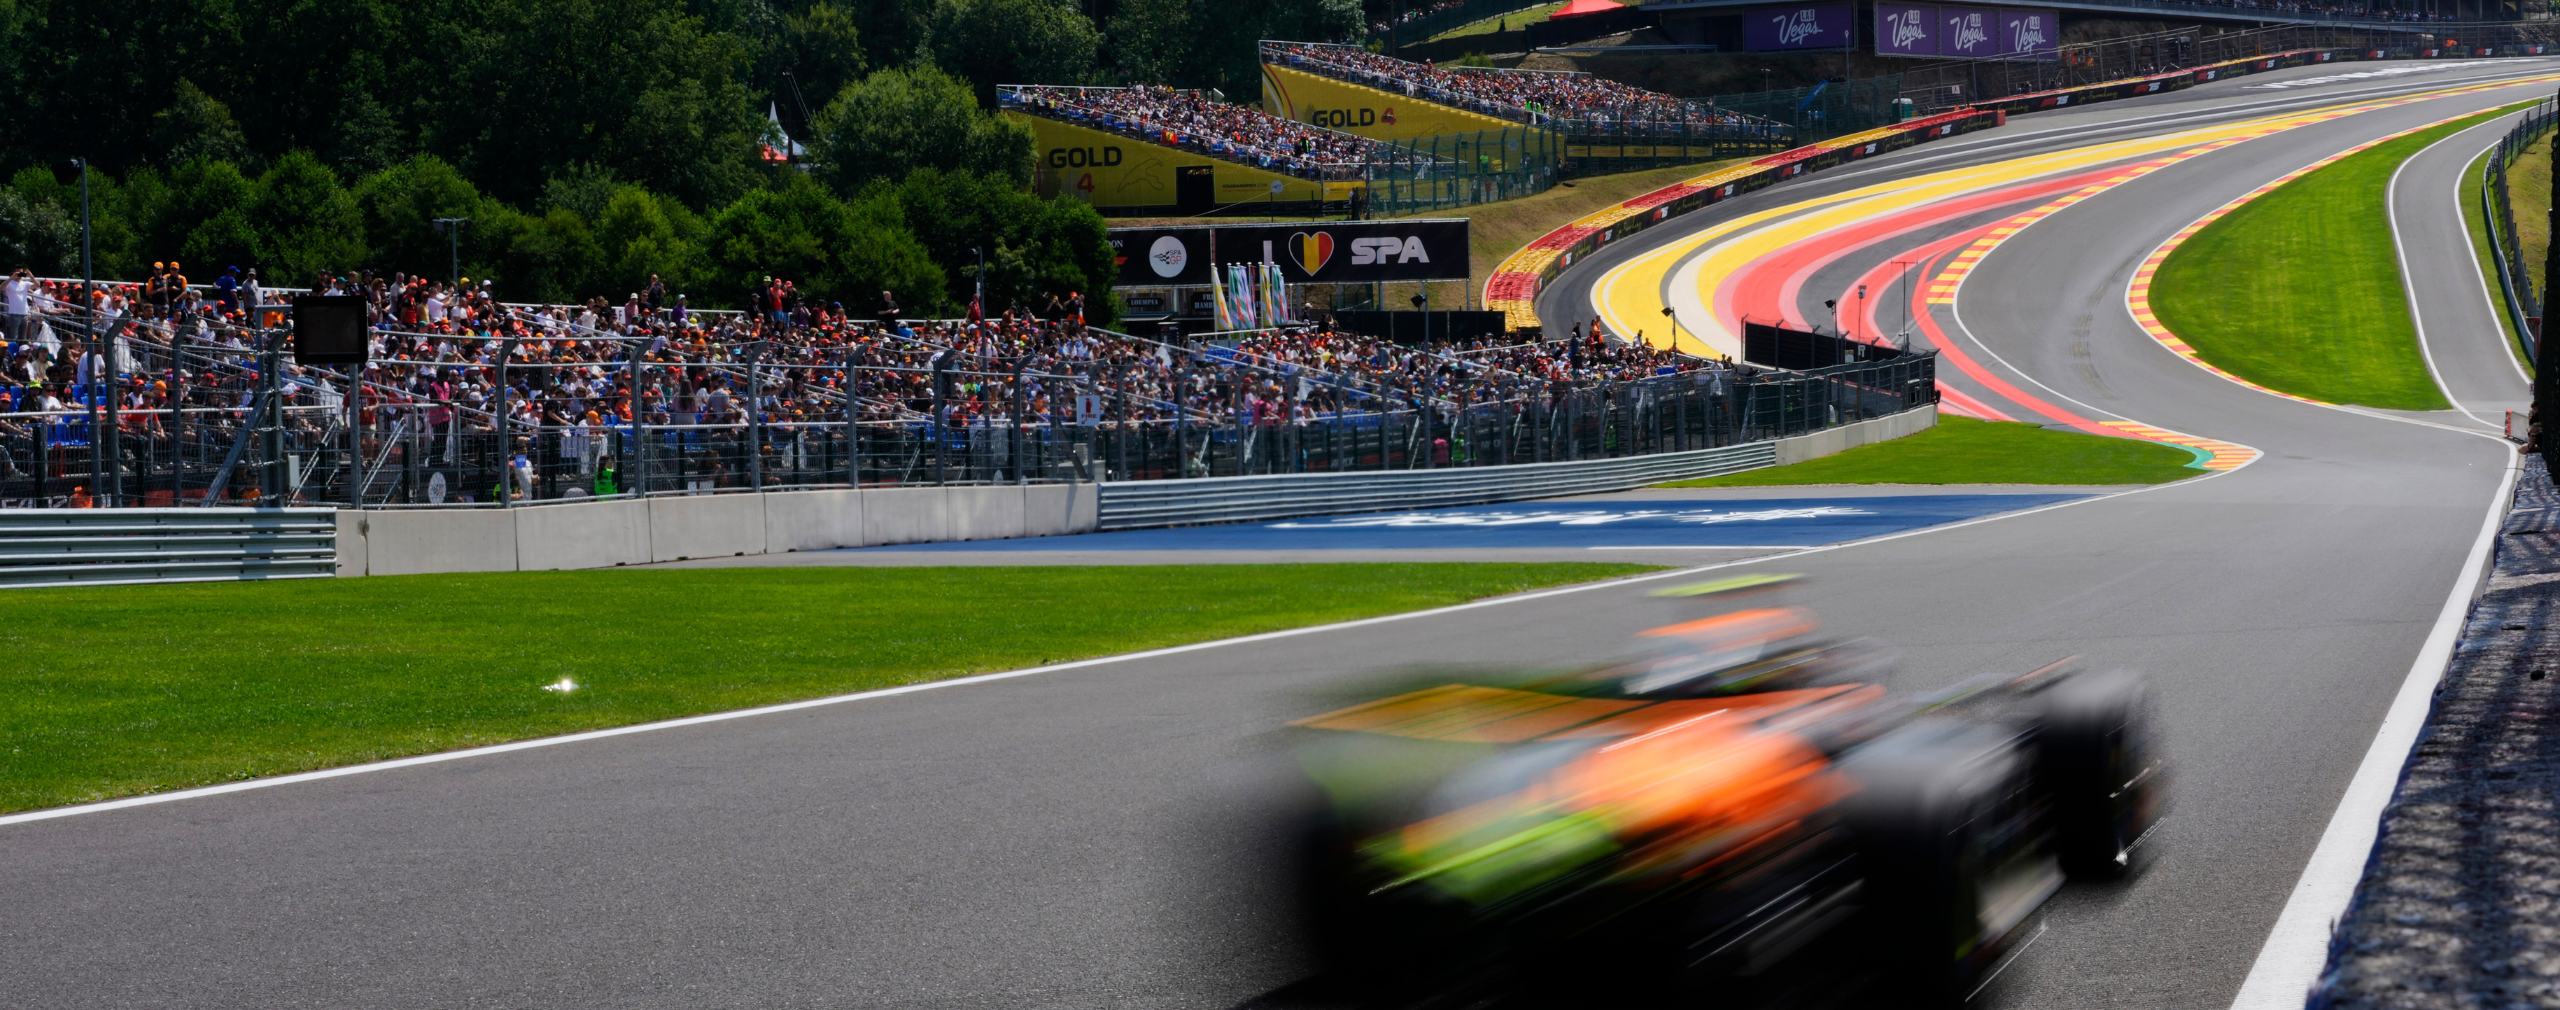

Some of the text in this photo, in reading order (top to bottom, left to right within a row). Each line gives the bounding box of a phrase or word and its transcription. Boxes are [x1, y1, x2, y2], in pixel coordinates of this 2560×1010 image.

[1801, 9, 1815, 21] LAS
[1772, 12, 1823, 45] Vegas
[1887, 12, 1926, 50] Vegas
[1950, 15, 1987, 53] Vegas
[2010, 18, 2046, 54] Vegas
[1312, 107, 1396, 128] GOLD 4
[1049, 146, 1122, 168] GOLD
[1077, 173, 1095, 193] 4
[1169, 255, 1182, 265] GP
[1263, 235, 1430, 266] I SPA
